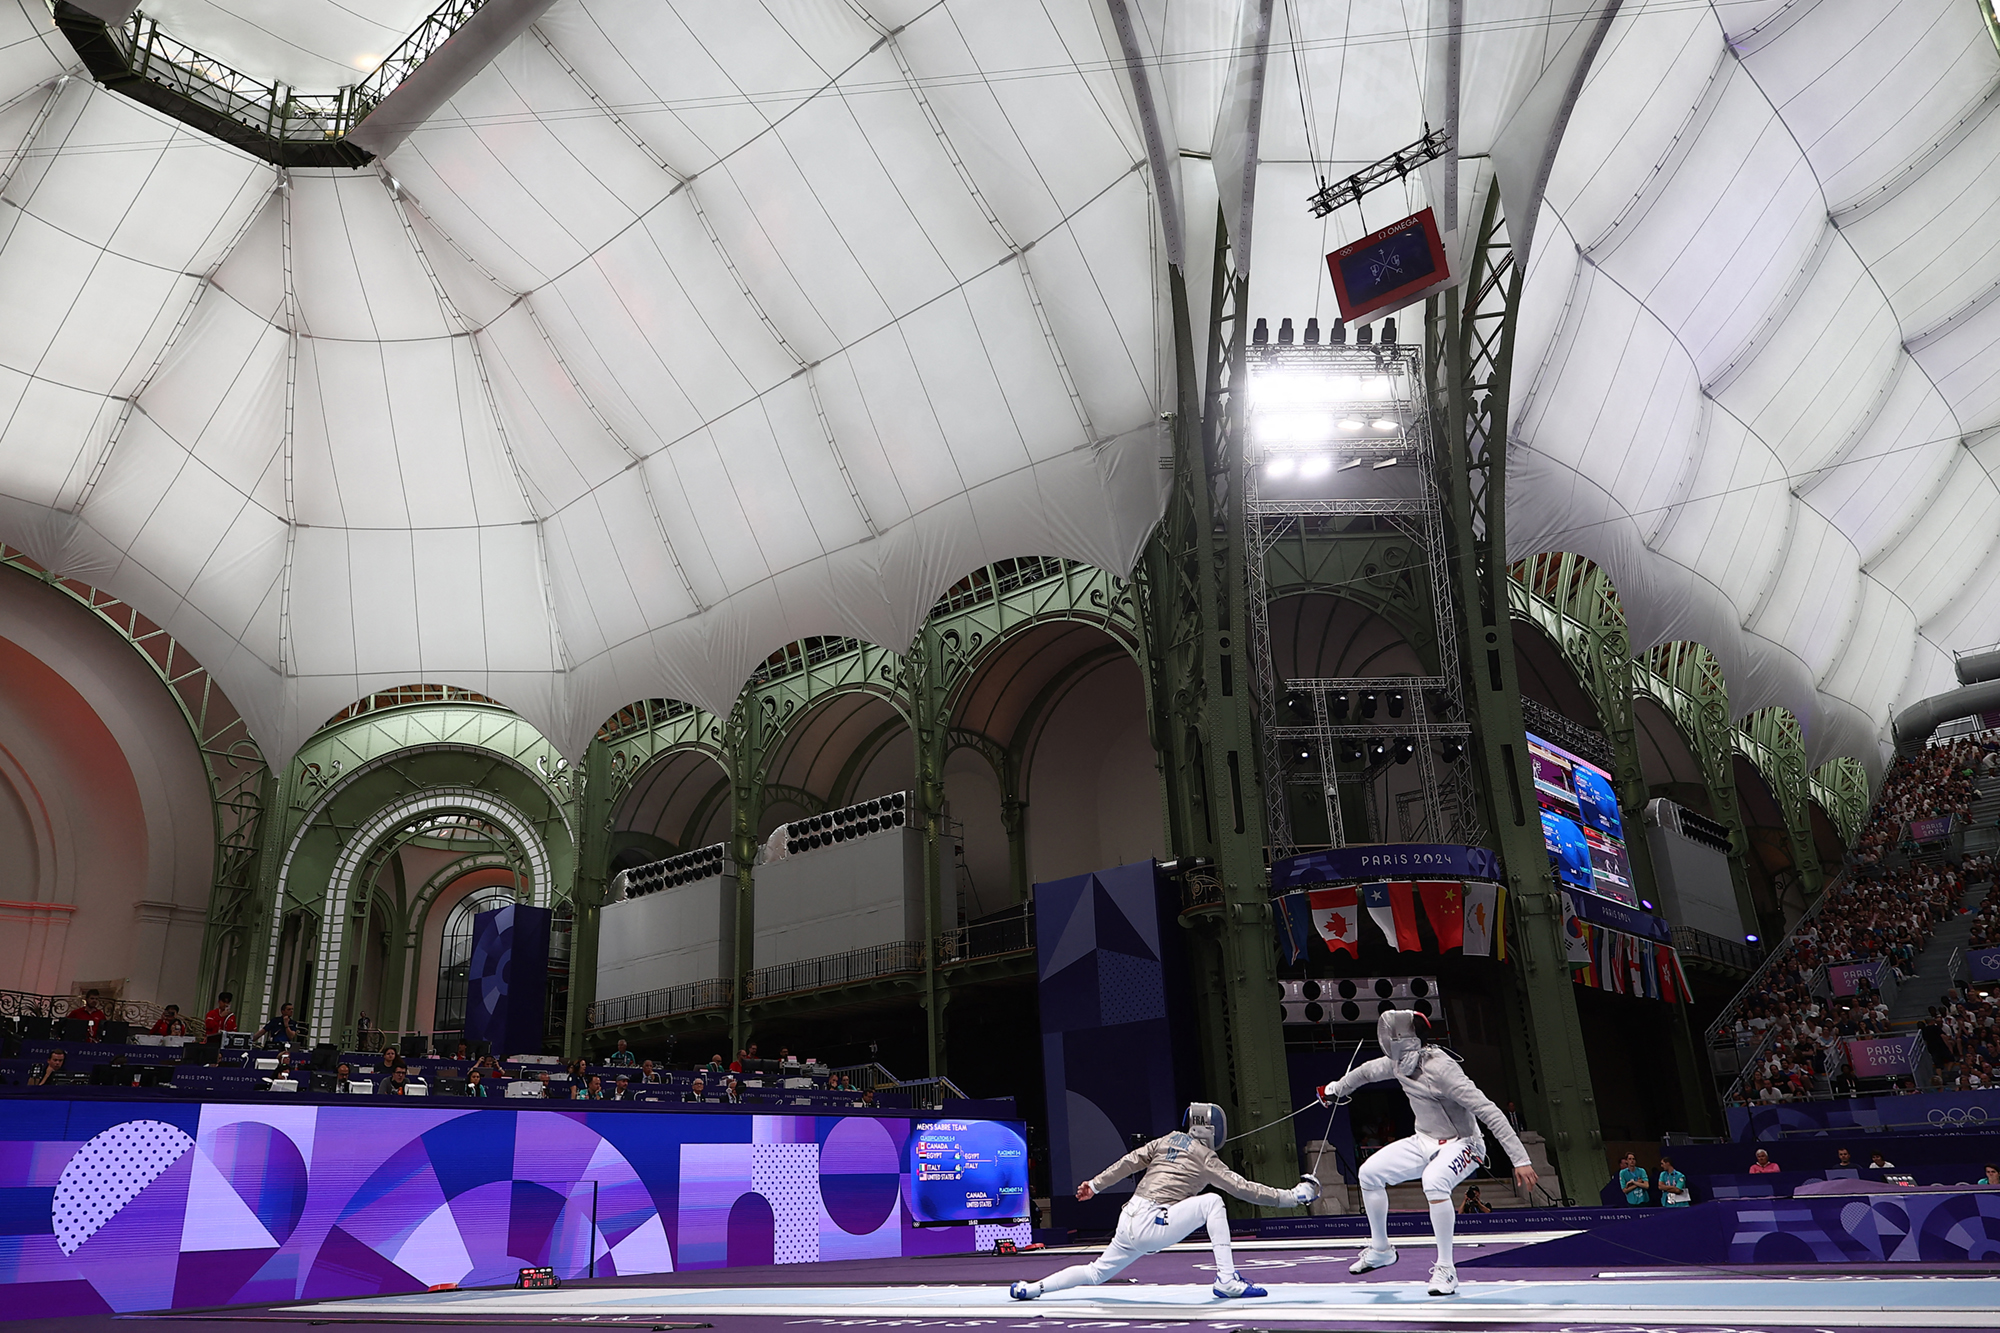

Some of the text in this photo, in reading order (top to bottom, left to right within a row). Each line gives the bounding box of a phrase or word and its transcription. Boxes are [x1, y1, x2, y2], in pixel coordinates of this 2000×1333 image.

[1387, 216, 1419, 236] OMEGA
[1413, 853, 1452, 864] 2024
[1869, 1055, 1906, 1066] 2024
